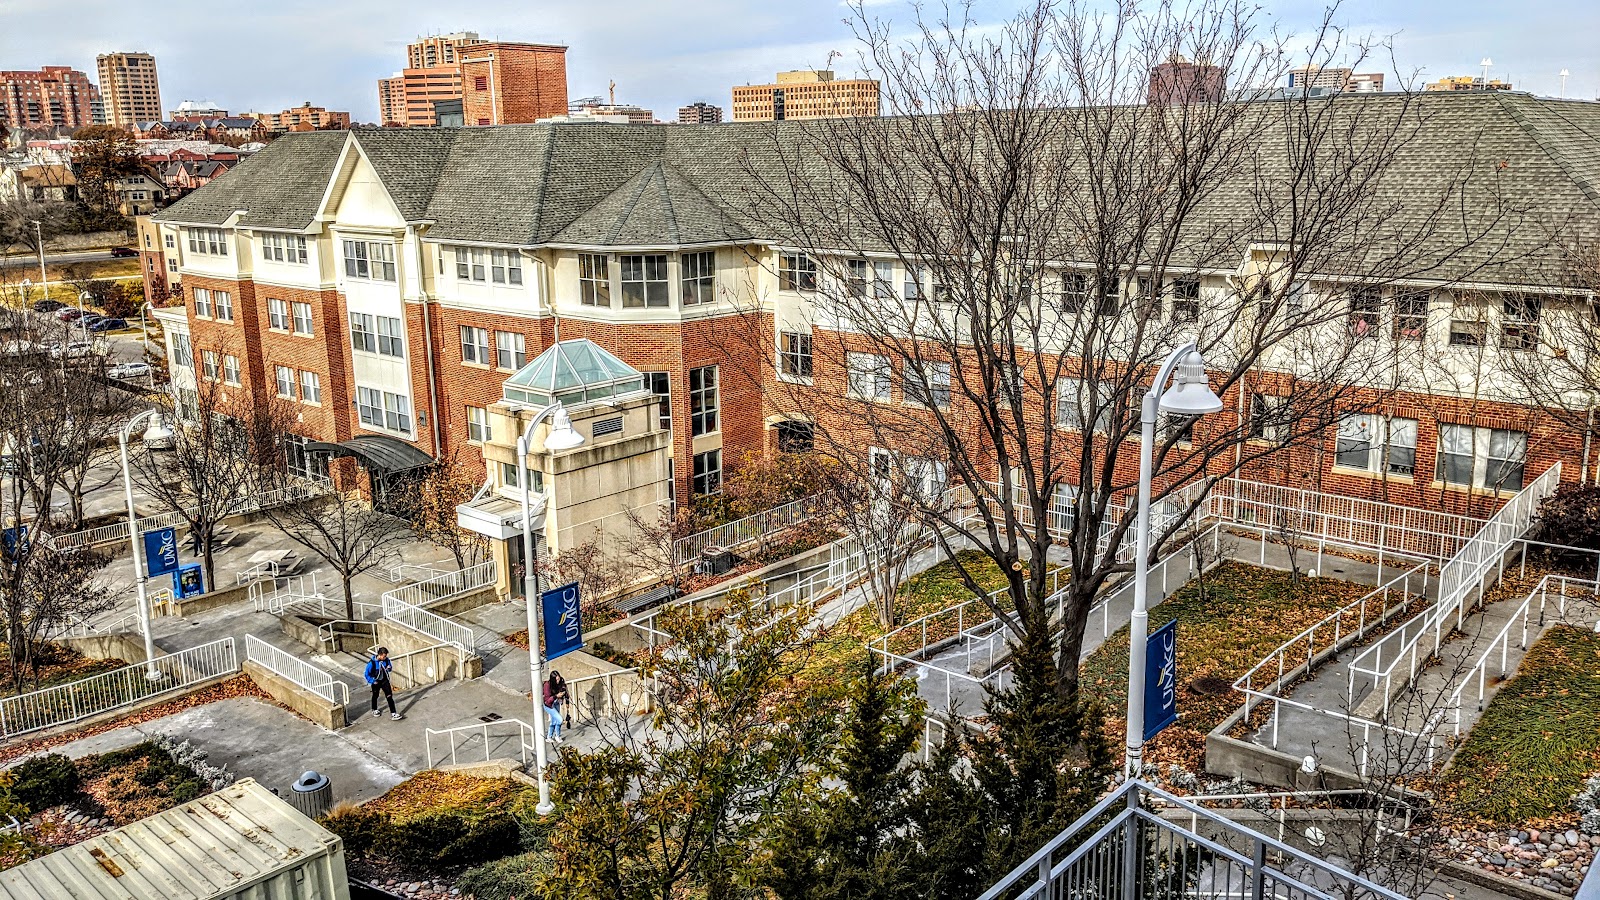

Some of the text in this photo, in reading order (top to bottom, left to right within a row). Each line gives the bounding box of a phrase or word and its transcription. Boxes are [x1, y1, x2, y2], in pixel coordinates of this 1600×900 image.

[161, 530, 176, 567] UMKC
[562, 587, 579, 641] UMKC
[1163, 629, 1174, 711] UMKC
